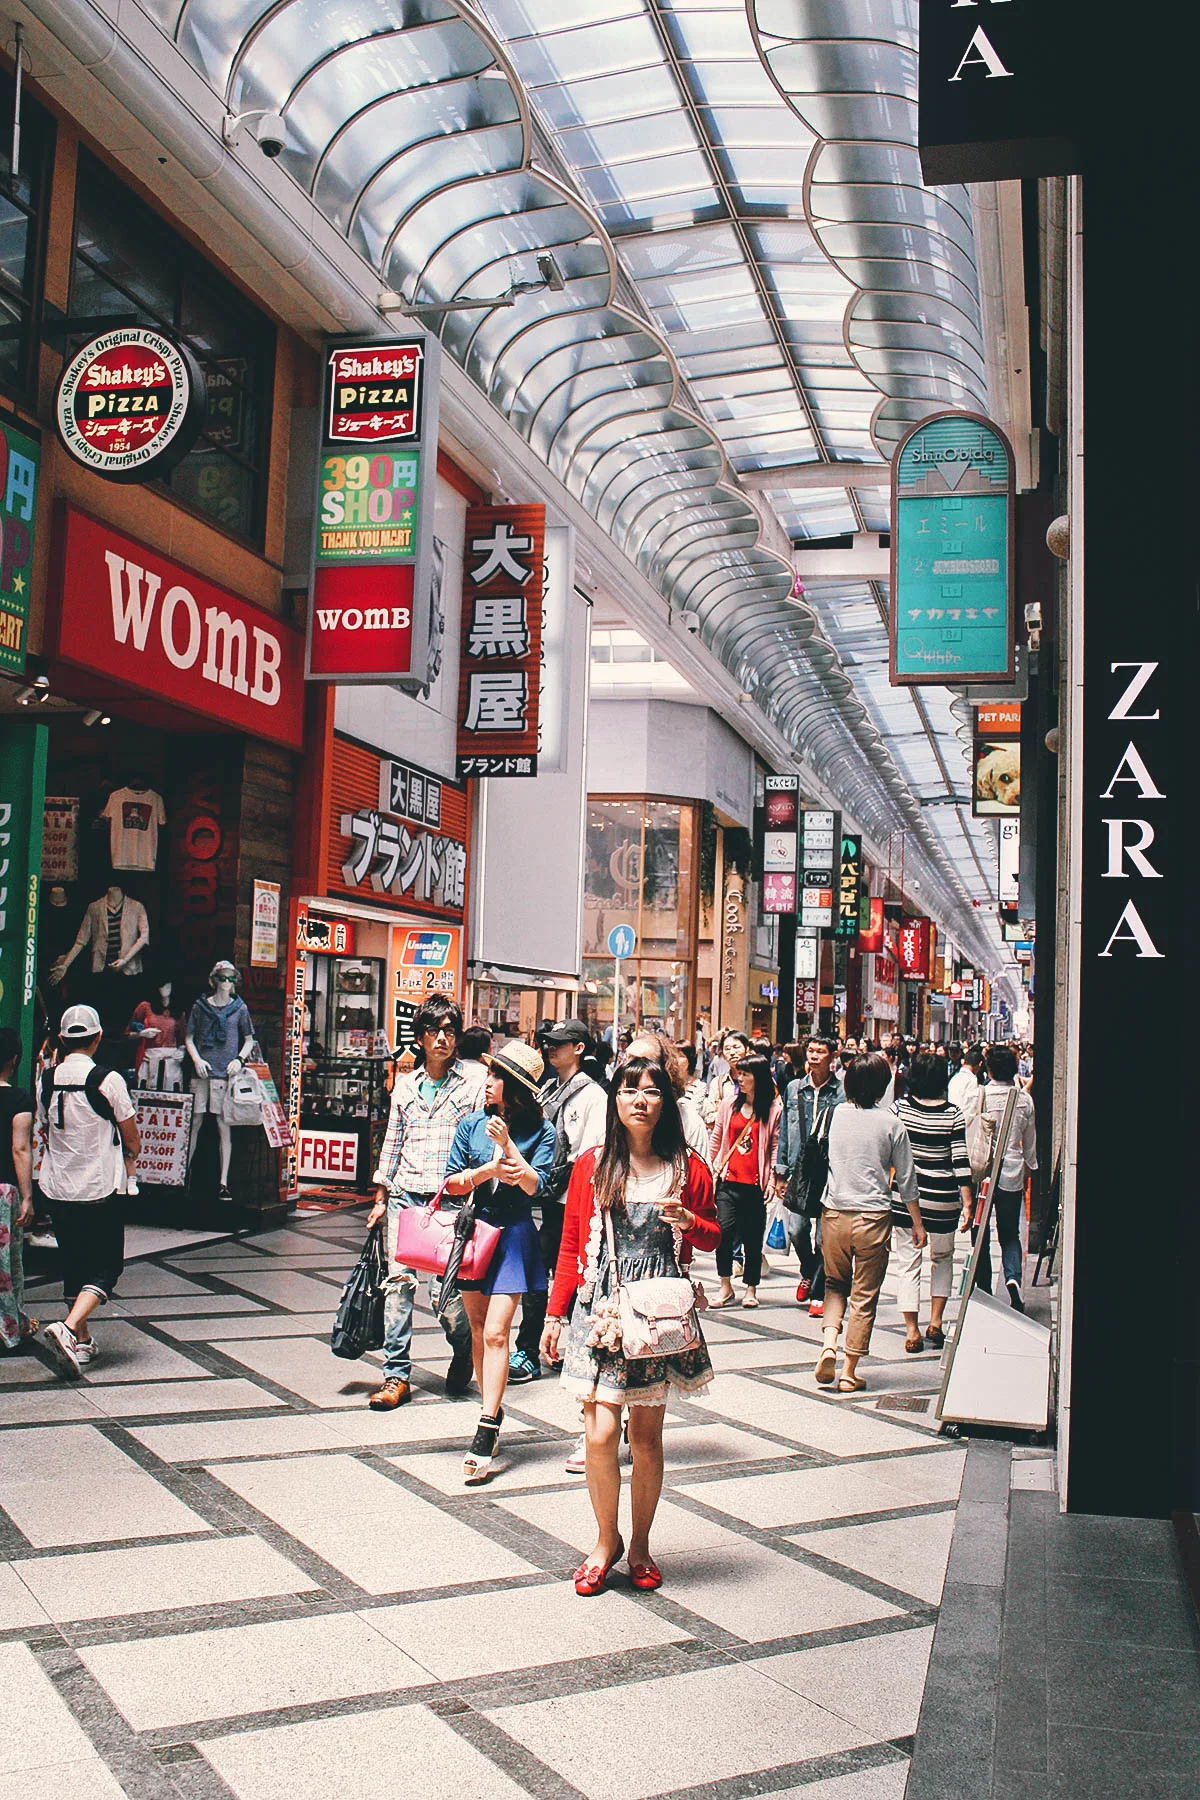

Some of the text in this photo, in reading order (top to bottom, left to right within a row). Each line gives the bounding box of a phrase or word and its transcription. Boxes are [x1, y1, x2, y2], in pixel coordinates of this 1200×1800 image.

[948, 0, 1014, 82] A
[63, 350, 95, 396] Shakey's
[95, 331, 141, 352] Original
[143, 332, 174, 359] Crispy
[170, 357, 184, 390] Pizza
[85, 362, 166, 387] Shakey's
[337, 355, 415, 378] Shakey's
[63, 406, 77, 439] Pizza
[84, 416, 159, 437] シェーキーズ
[151, 402, 184, 450] Shakey's
[337, 412, 410, 432] シェーキーズ
[74, 437, 103, 464] Crispy
[104, 448, 151, 467] Original
[109, 442, 131, 452] 1954
[323, 455, 417, 491] 390円
[321, 488, 415, 525] SHOP
[321, 529, 412, 549] THANK YOU MART
[464, 524, 535, 735] 大黒屋
[978, 712, 997, 722] PET
[461, 757, 532, 775] ブランド館
[391, 770, 441, 823] 大黒屋
[1098, 662, 1167, 958] ZARA
[351, 811, 467, 908] ブランド館
[725, 889, 745, 933] Cook
[407, 940, 448, 953] UnionPay
[136, 1112, 183, 1128] SALE
[140, 1130, 177, 1142] 10%OFF
[135, 1160, 173, 1172] 20%OFF
[300, 1137, 356, 1173] FREE
